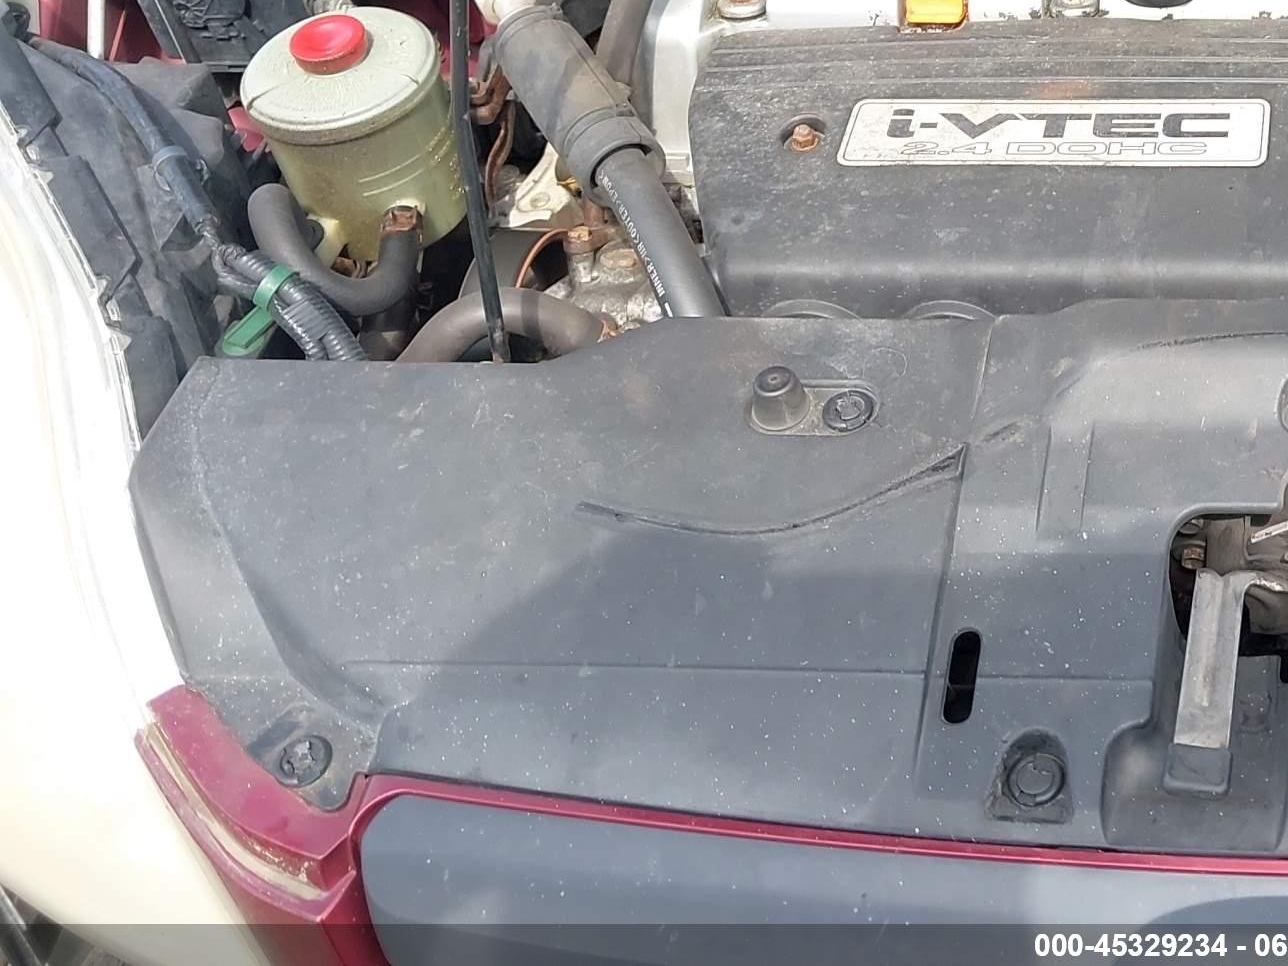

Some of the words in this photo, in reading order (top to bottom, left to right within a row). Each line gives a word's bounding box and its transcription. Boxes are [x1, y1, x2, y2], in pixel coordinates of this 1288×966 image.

[885, 108, 1231, 139] i-VTEC
[899, 140, 992, 155] 2.4
[1005, 141, 1208, 155] DOHC
